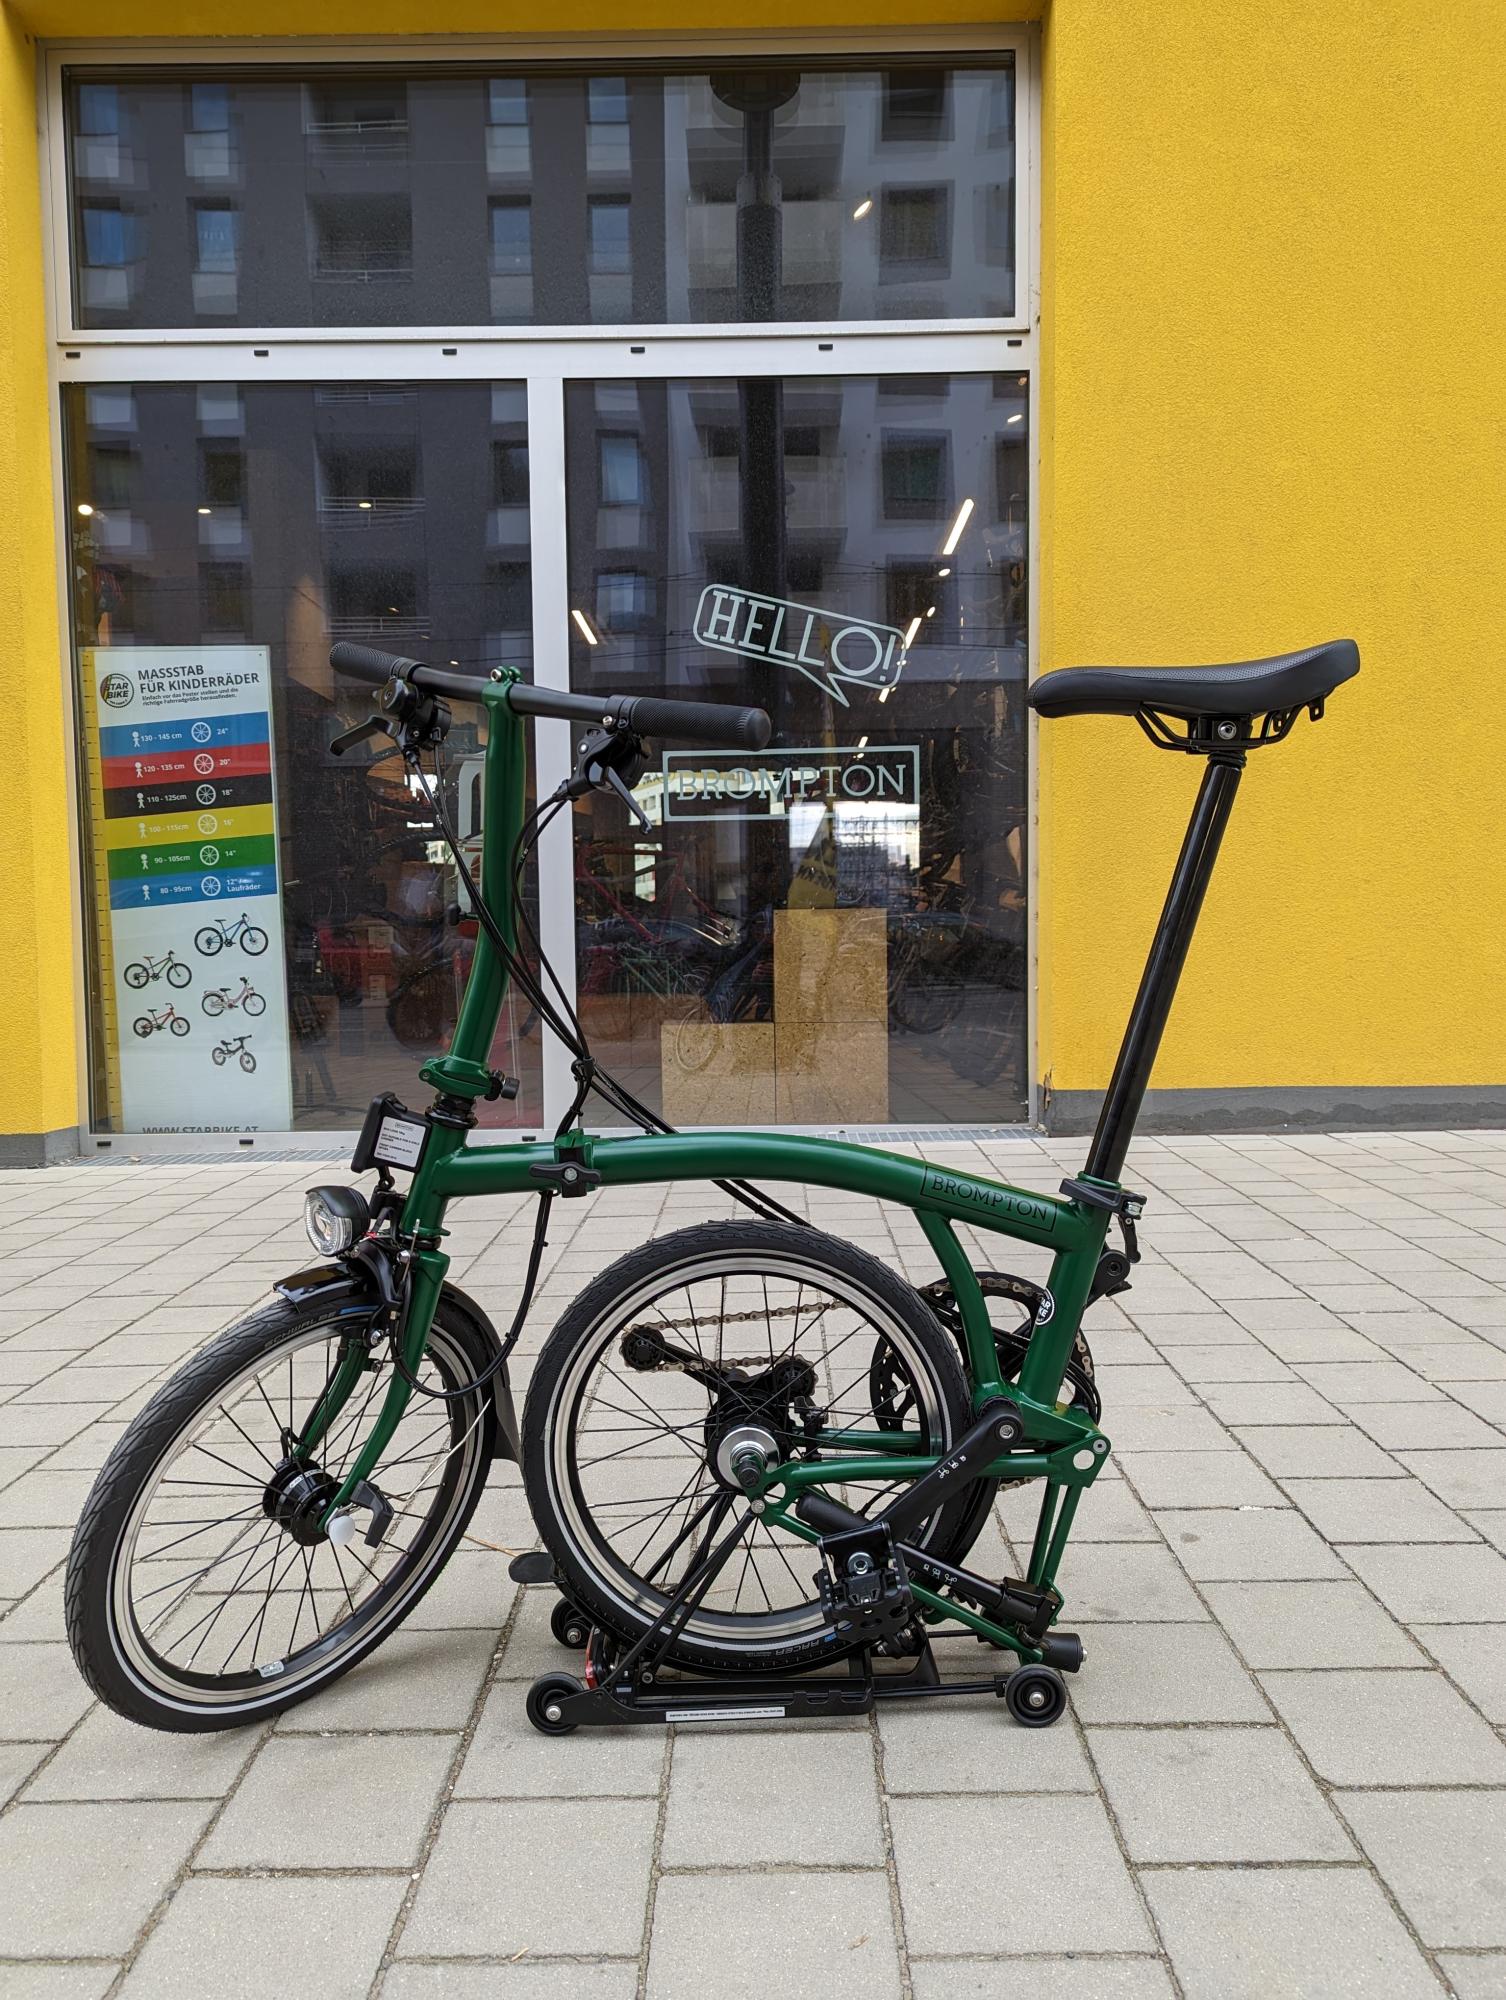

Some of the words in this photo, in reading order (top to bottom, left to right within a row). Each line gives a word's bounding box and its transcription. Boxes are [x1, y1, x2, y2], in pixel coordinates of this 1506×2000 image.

[703, 590, 896, 682] HELLO!
[138, 664, 204, 680] MASSSTAB
[140, 680, 165, 694] FÜR
[168, 672, 260, 691] KINDERRÄDER
[106, 690, 129, 699] BIKE
[219, 758, 231, 766] 20"
[677, 764, 906, 801] BROMPTON
[164, 794, 187, 802] 125cm
[227, 883, 262, 893] Laufräder
[932, 1174, 1048, 1222] BROMPTON
